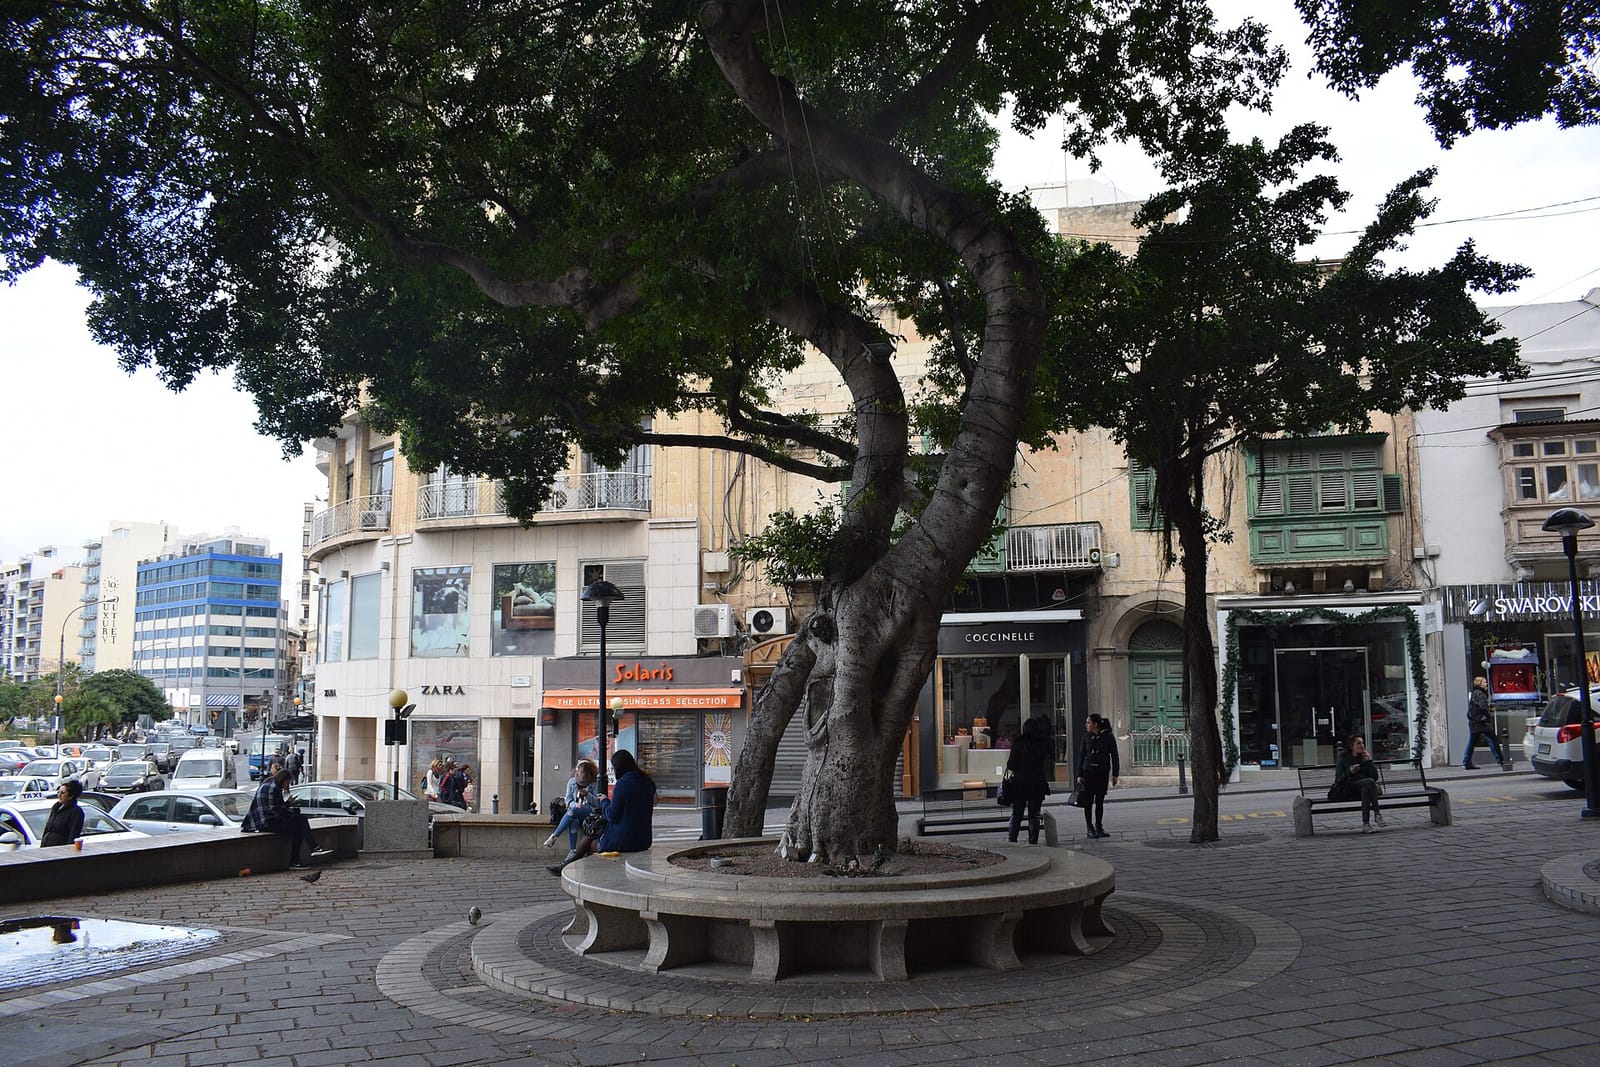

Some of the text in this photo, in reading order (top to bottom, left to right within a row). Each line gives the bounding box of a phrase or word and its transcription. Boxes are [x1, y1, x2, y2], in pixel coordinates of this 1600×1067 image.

[965, 632, 1035, 642] COCCINELLE
[613, 663, 674, 683] Solaris
[421, 685, 466, 695] ZARA
[557, 698, 573, 706] THE
[623, 697, 671, 705] SUNGLASS
[676, 697, 727, 705] SELECTION
